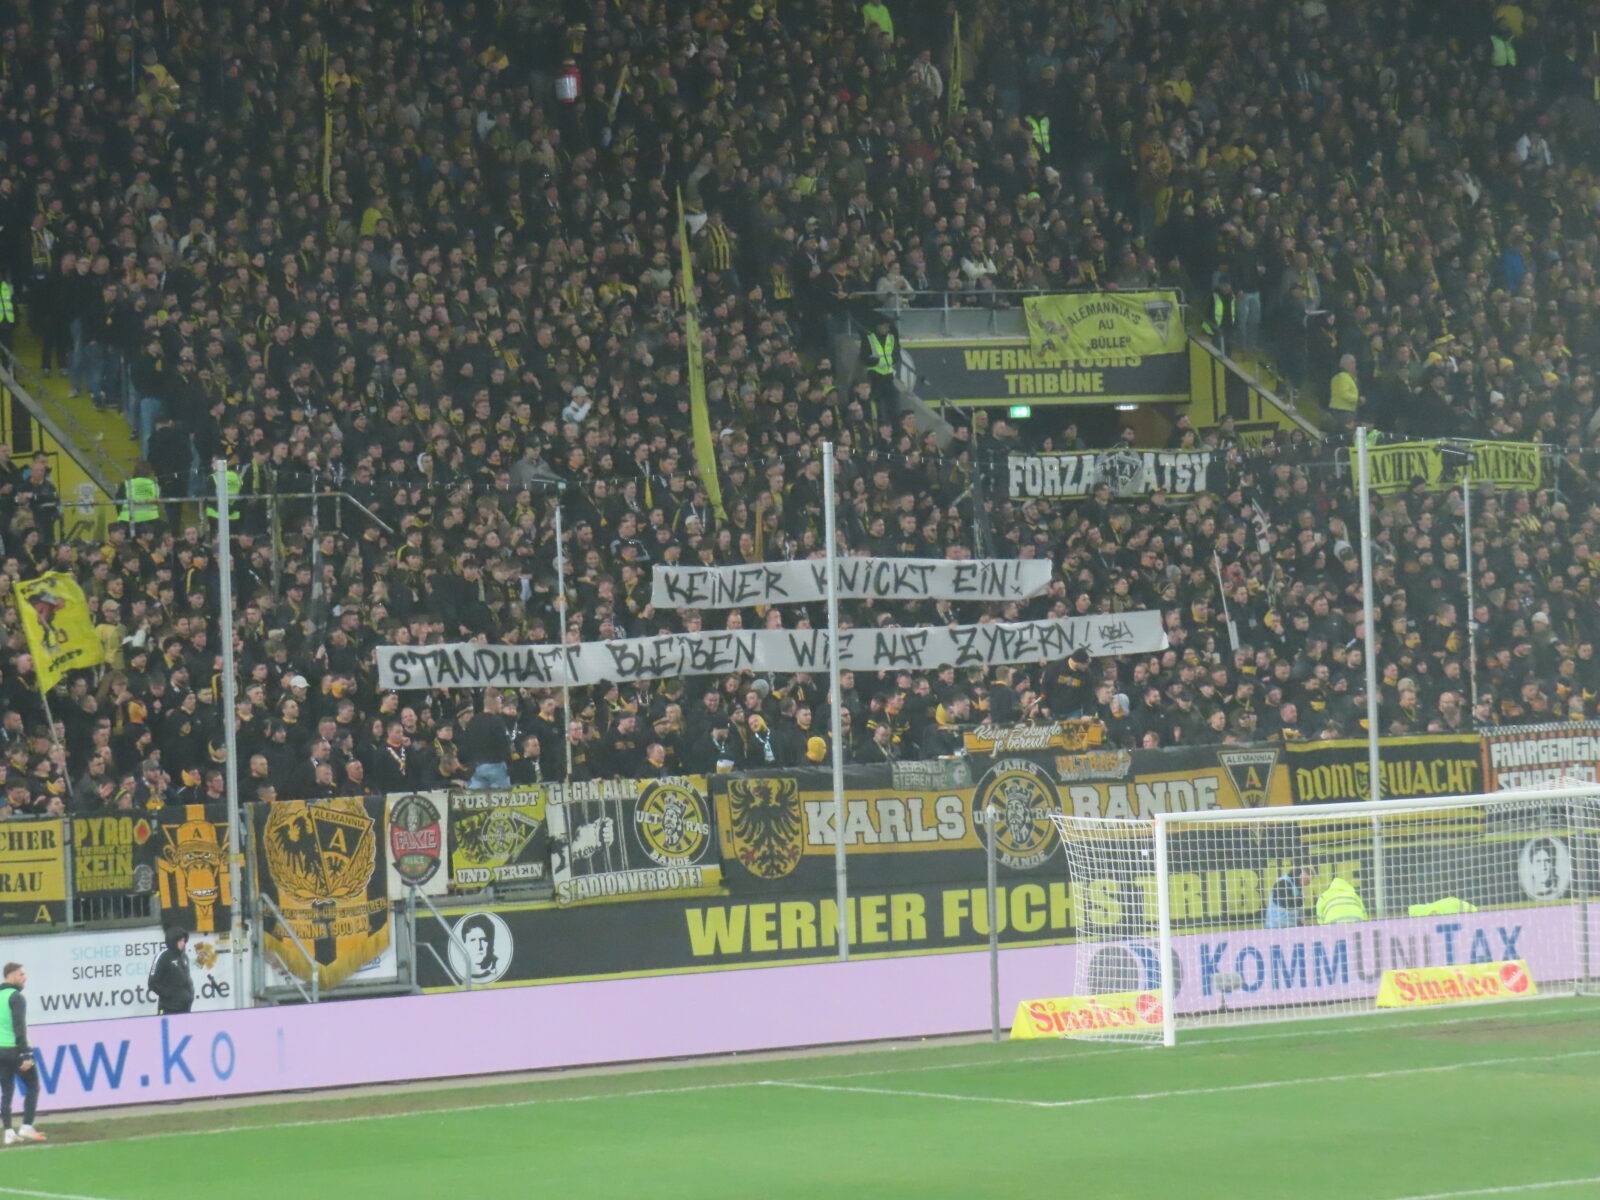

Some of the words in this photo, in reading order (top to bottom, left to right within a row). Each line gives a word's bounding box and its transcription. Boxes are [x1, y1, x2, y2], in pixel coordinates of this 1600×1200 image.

[1004, 369, 1104, 395] TRIBÜNE
[1008, 453, 1096, 497] FORZA
[1141, 451, 1211, 494] ATSV
[389, 645, 581, 688] STANDHAFT
[873, 629, 928, 666] AUF
[950, 621, 1093, 664] ZYPERN!
[1226, 753, 1273, 766] ALEMANNIA
[1245, 767, 1262, 787] A
[452, 792, 488, 809] FÜR
[490, 791, 539, 807] STADT
[74, 816, 132, 848] PYRO
[314, 811, 367, 829] ALEMANNIA
[804, 796, 967, 845] KARLS
[328, 827, 347, 853] A
[75, 854, 134, 878] KEIN
[1001, 850, 1049, 869] BANDE
[457, 868, 491, 884] UND
[493, 863, 544, 880] VEREIN
[558, 867, 703, 905] STADIONVERBOTE!
[686, 892, 927, 956] WERNER
[942, 877, 1122, 938] FUCHS
[72, 963, 122, 980] SICHER
[1393, 969, 1500, 1002] Sinalco
[1030, 998, 1136, 1033] Sinalco
